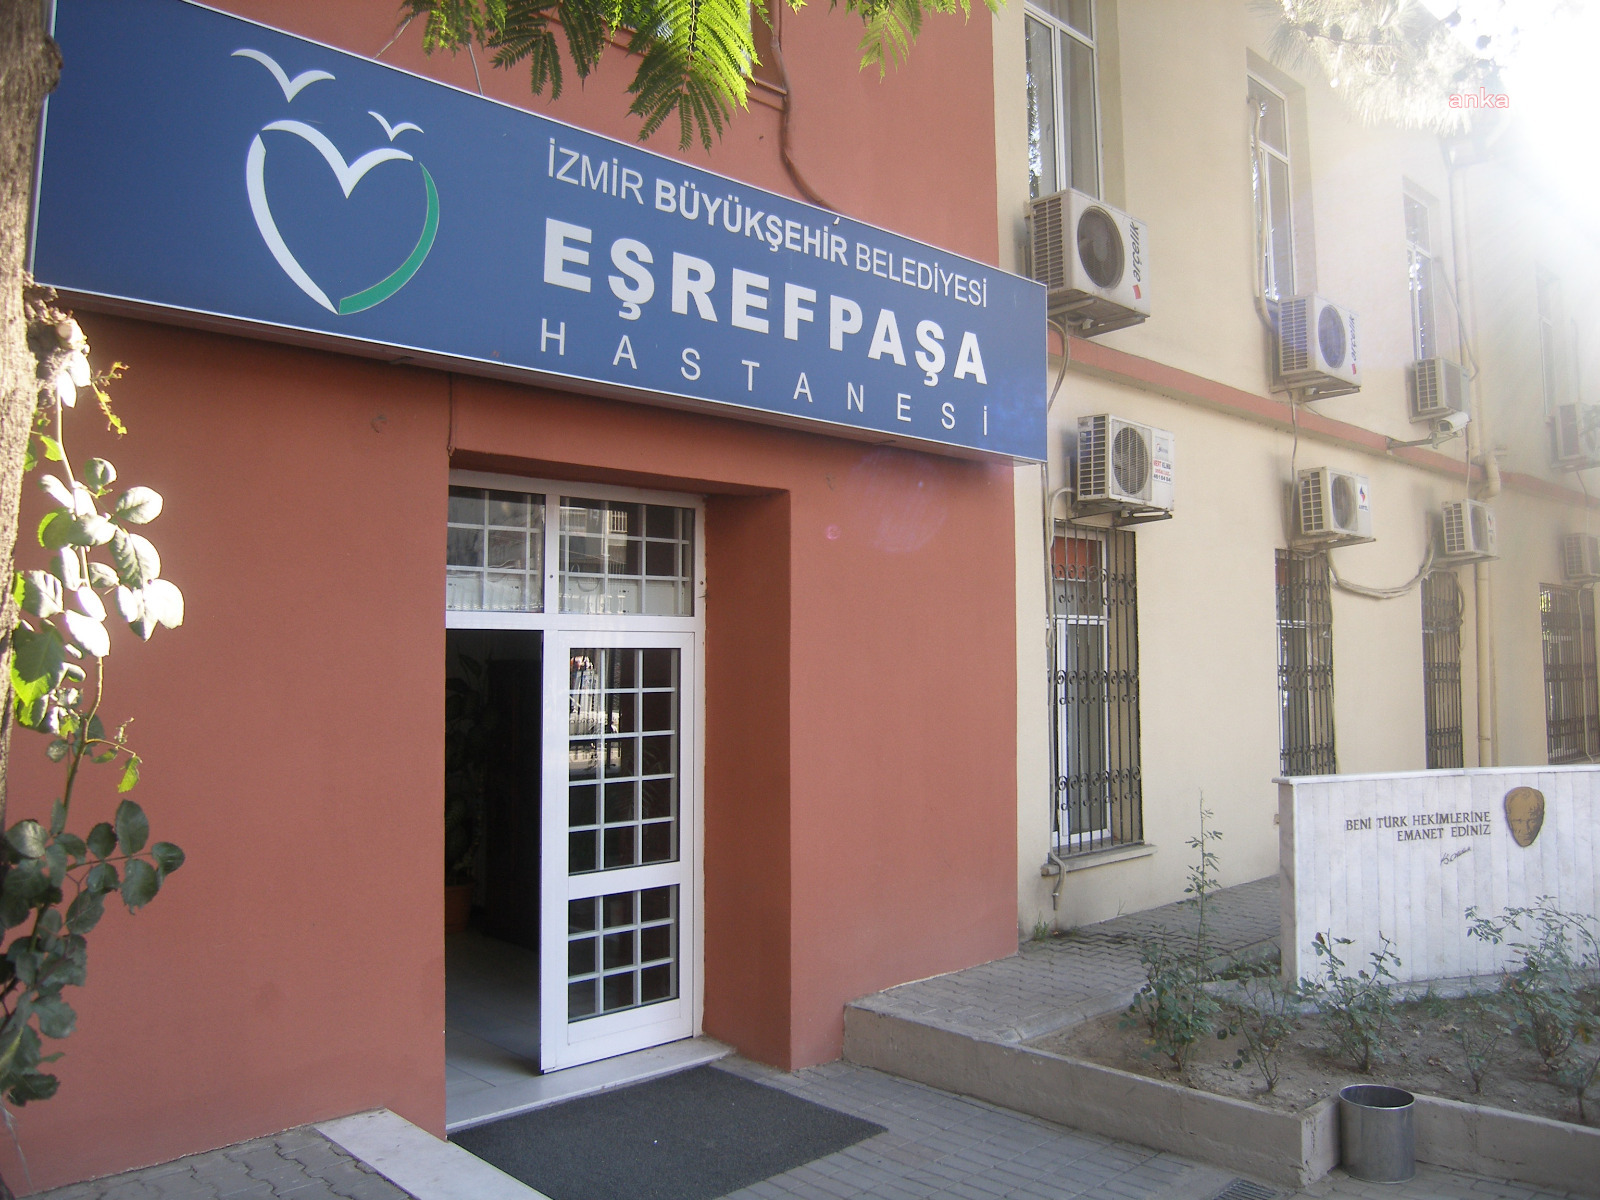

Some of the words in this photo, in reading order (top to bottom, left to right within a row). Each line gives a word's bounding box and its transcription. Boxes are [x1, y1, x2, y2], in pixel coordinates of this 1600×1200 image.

[547, 138, 644, 204] İZMİR
[655, 178, 848, 266] BÜYÜKŞEHİR
[856, 243, 988, 308] BELEDİYESİ
[543, 217, 988, 387] EŞREFPAŞA
[1345, 817, 1372, 832] BENİ
[1376, 814, 1408, 829] TÜRK
[1412, 811, 1492, 826] HEKİMLERİNE
[1397, 827, 1444, 842] EMANET
[1450, 824, 1492, 838] EDİNİZ
